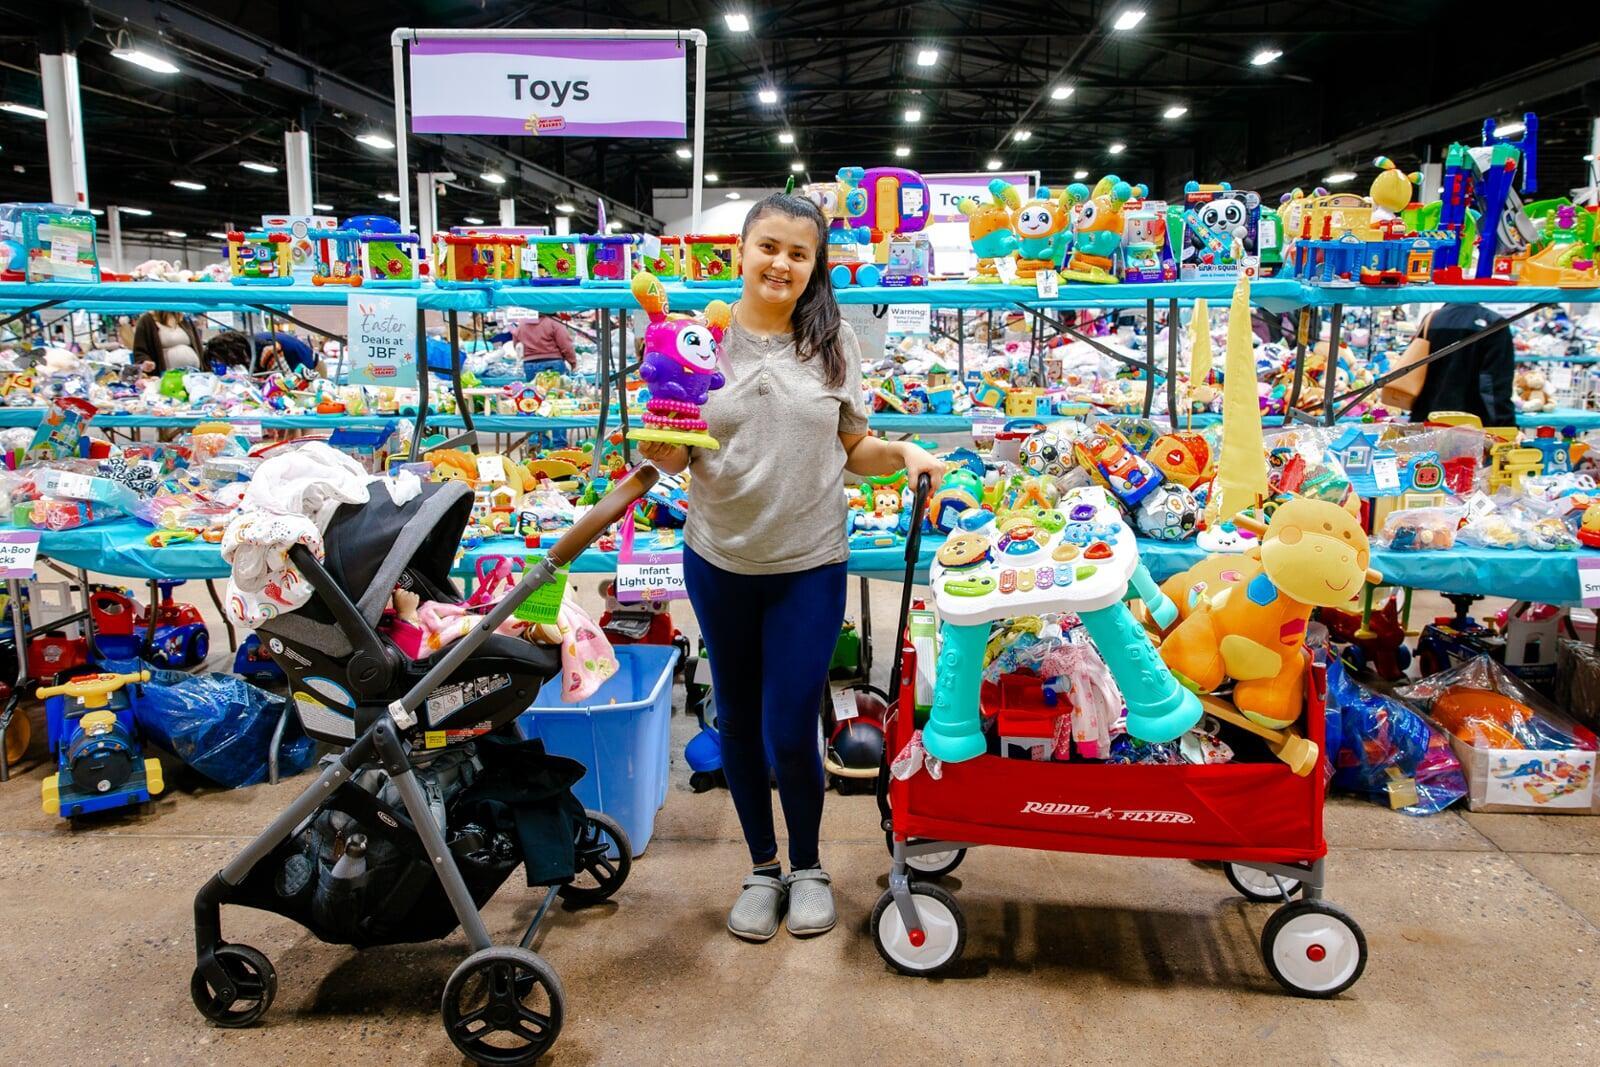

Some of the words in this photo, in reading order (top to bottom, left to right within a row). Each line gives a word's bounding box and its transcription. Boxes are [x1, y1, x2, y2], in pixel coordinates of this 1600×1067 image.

[507, 74, 590, 107] Toys
[939, 193, 980, 206] Tos
[648, 283, 658, 294] A
[891, 308, 928, 316] Warning:
[361, 314, 406, 333] Easter
[361, 335, 390, 344] Deals
[393, 335, 403, 345] at
[368, 346, 396, 358] JBF
[639, 567, 670, 575] Infant
[620, 577, 646, 587] Light
[649, 578, 664, 586] Up
[1021, 801, 1091, 815] RADIO
[1118, 811, 1193, 824] FLYER
